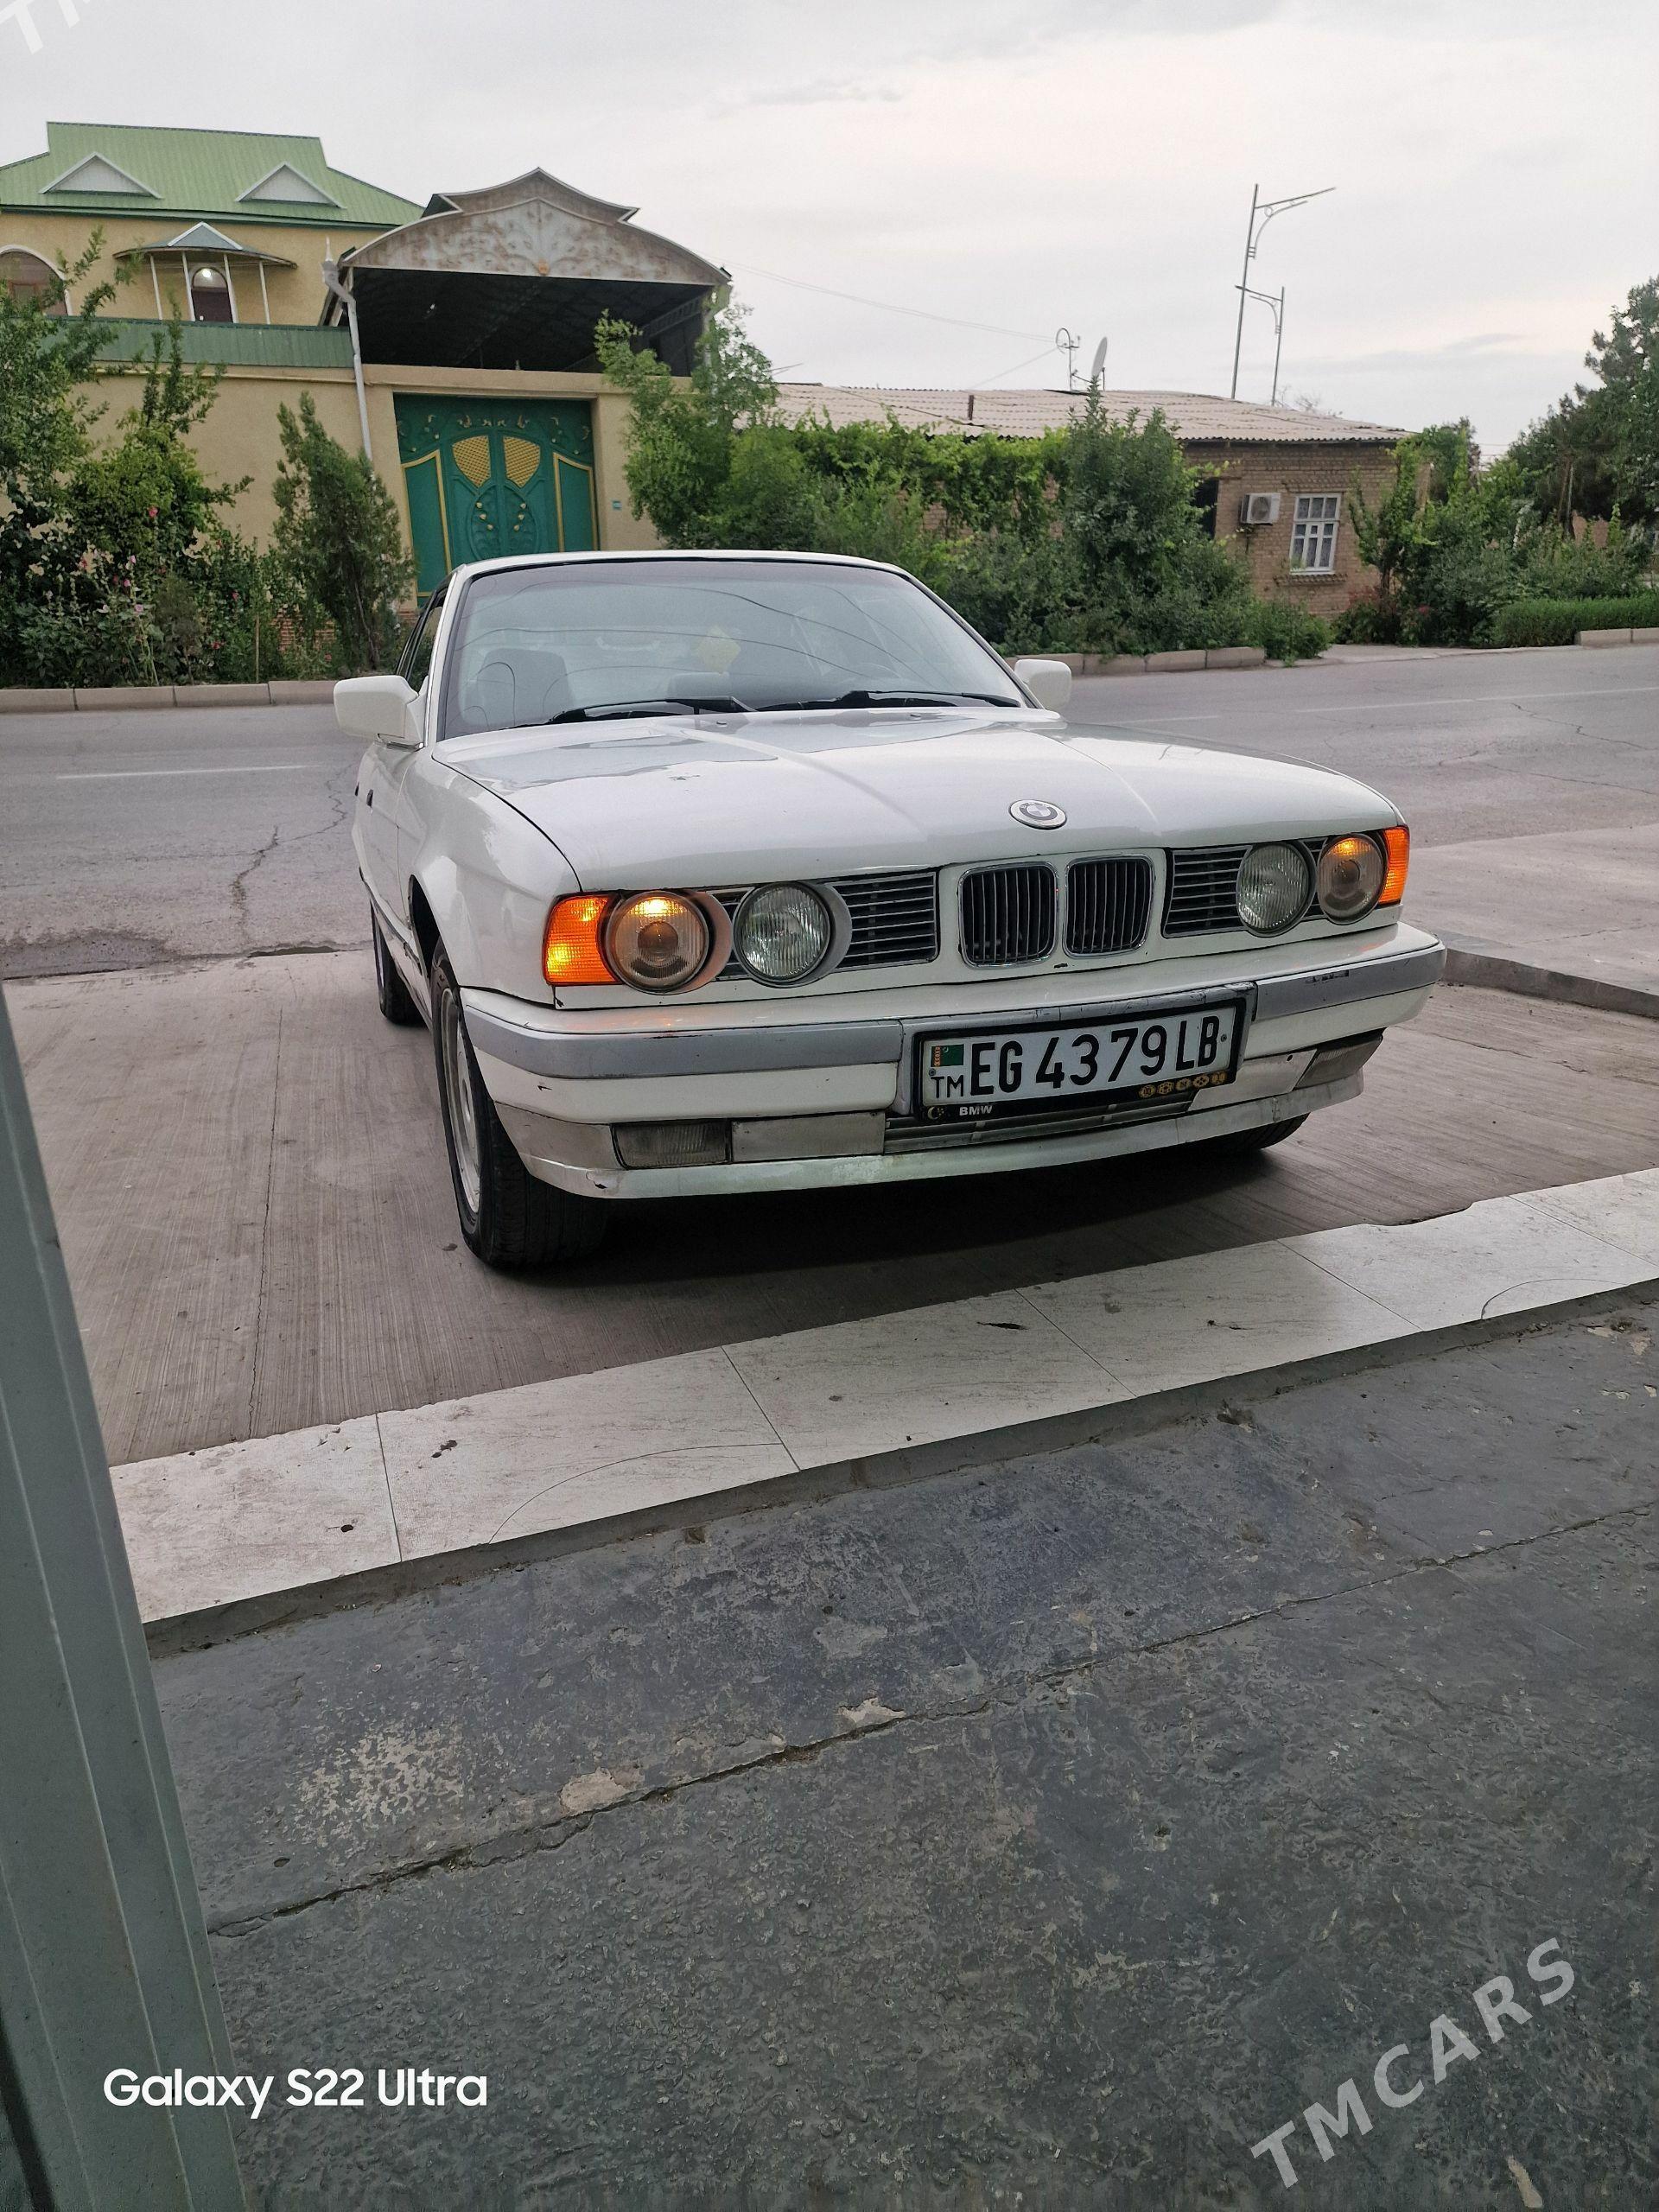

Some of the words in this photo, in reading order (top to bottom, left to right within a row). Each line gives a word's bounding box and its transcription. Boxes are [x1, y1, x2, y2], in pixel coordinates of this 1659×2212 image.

[969, 1040, 1023, 1096] EG
[1035, 1025, 1167, 1089] 4379
[1175, 1015, 1219, 1072] LB
[930, 1074, 964, 1099] TM
[959, 1105, 993, 1116] BMW
